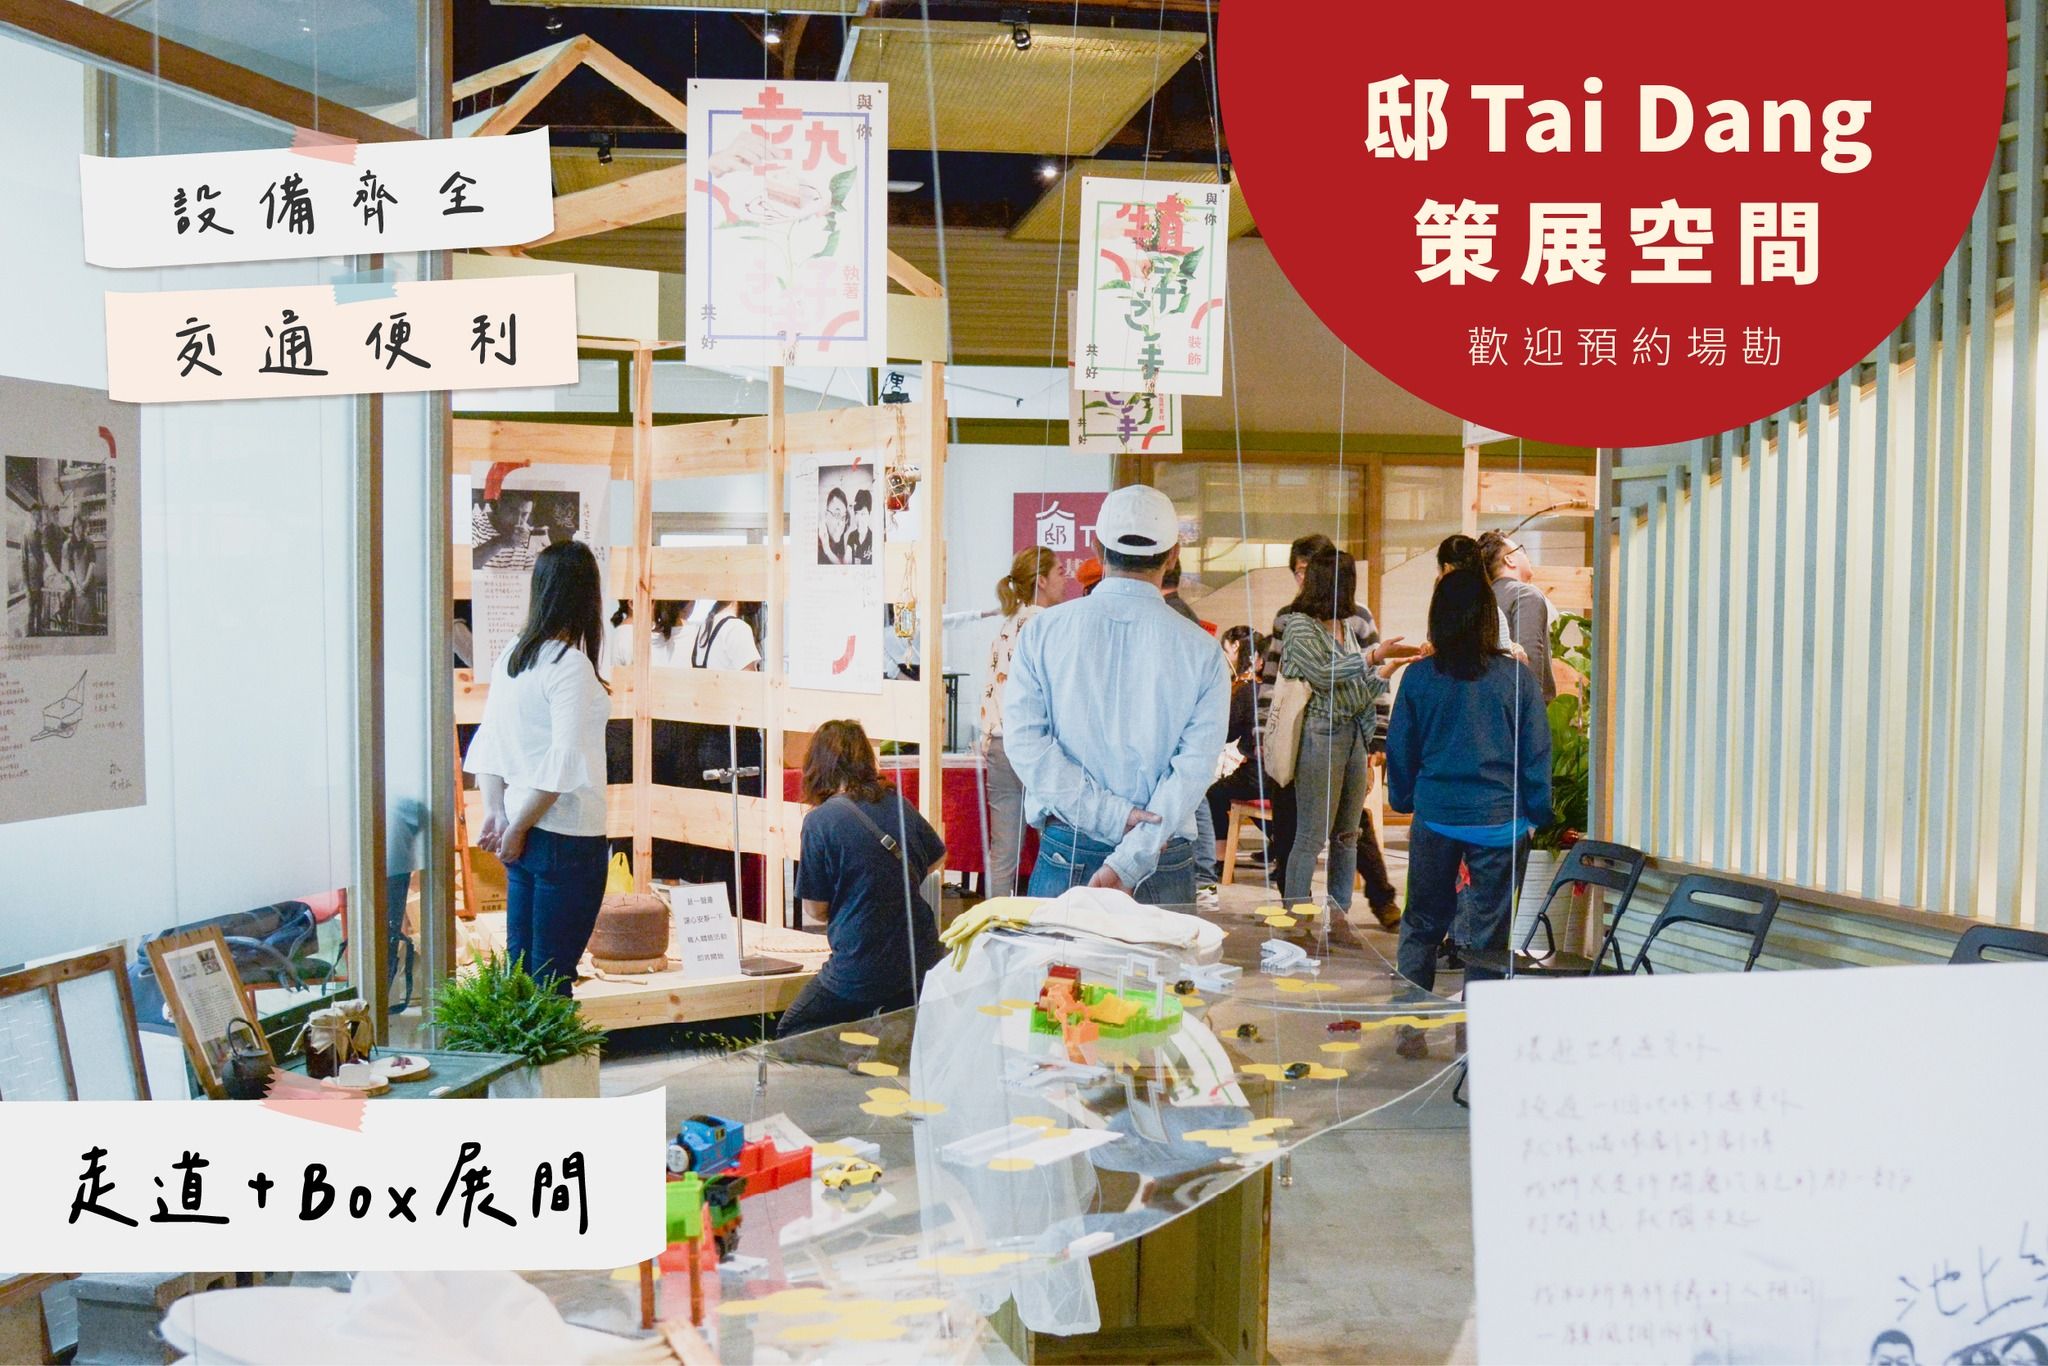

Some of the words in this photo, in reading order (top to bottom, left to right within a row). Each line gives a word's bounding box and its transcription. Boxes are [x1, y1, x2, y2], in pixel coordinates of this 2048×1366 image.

[857, 94, 873, 140] 與你
[1204, 192, 1218, 226] 與你
[701, 303, 717, 350] 共好
[1086, 343, 1099, 379] 共好
